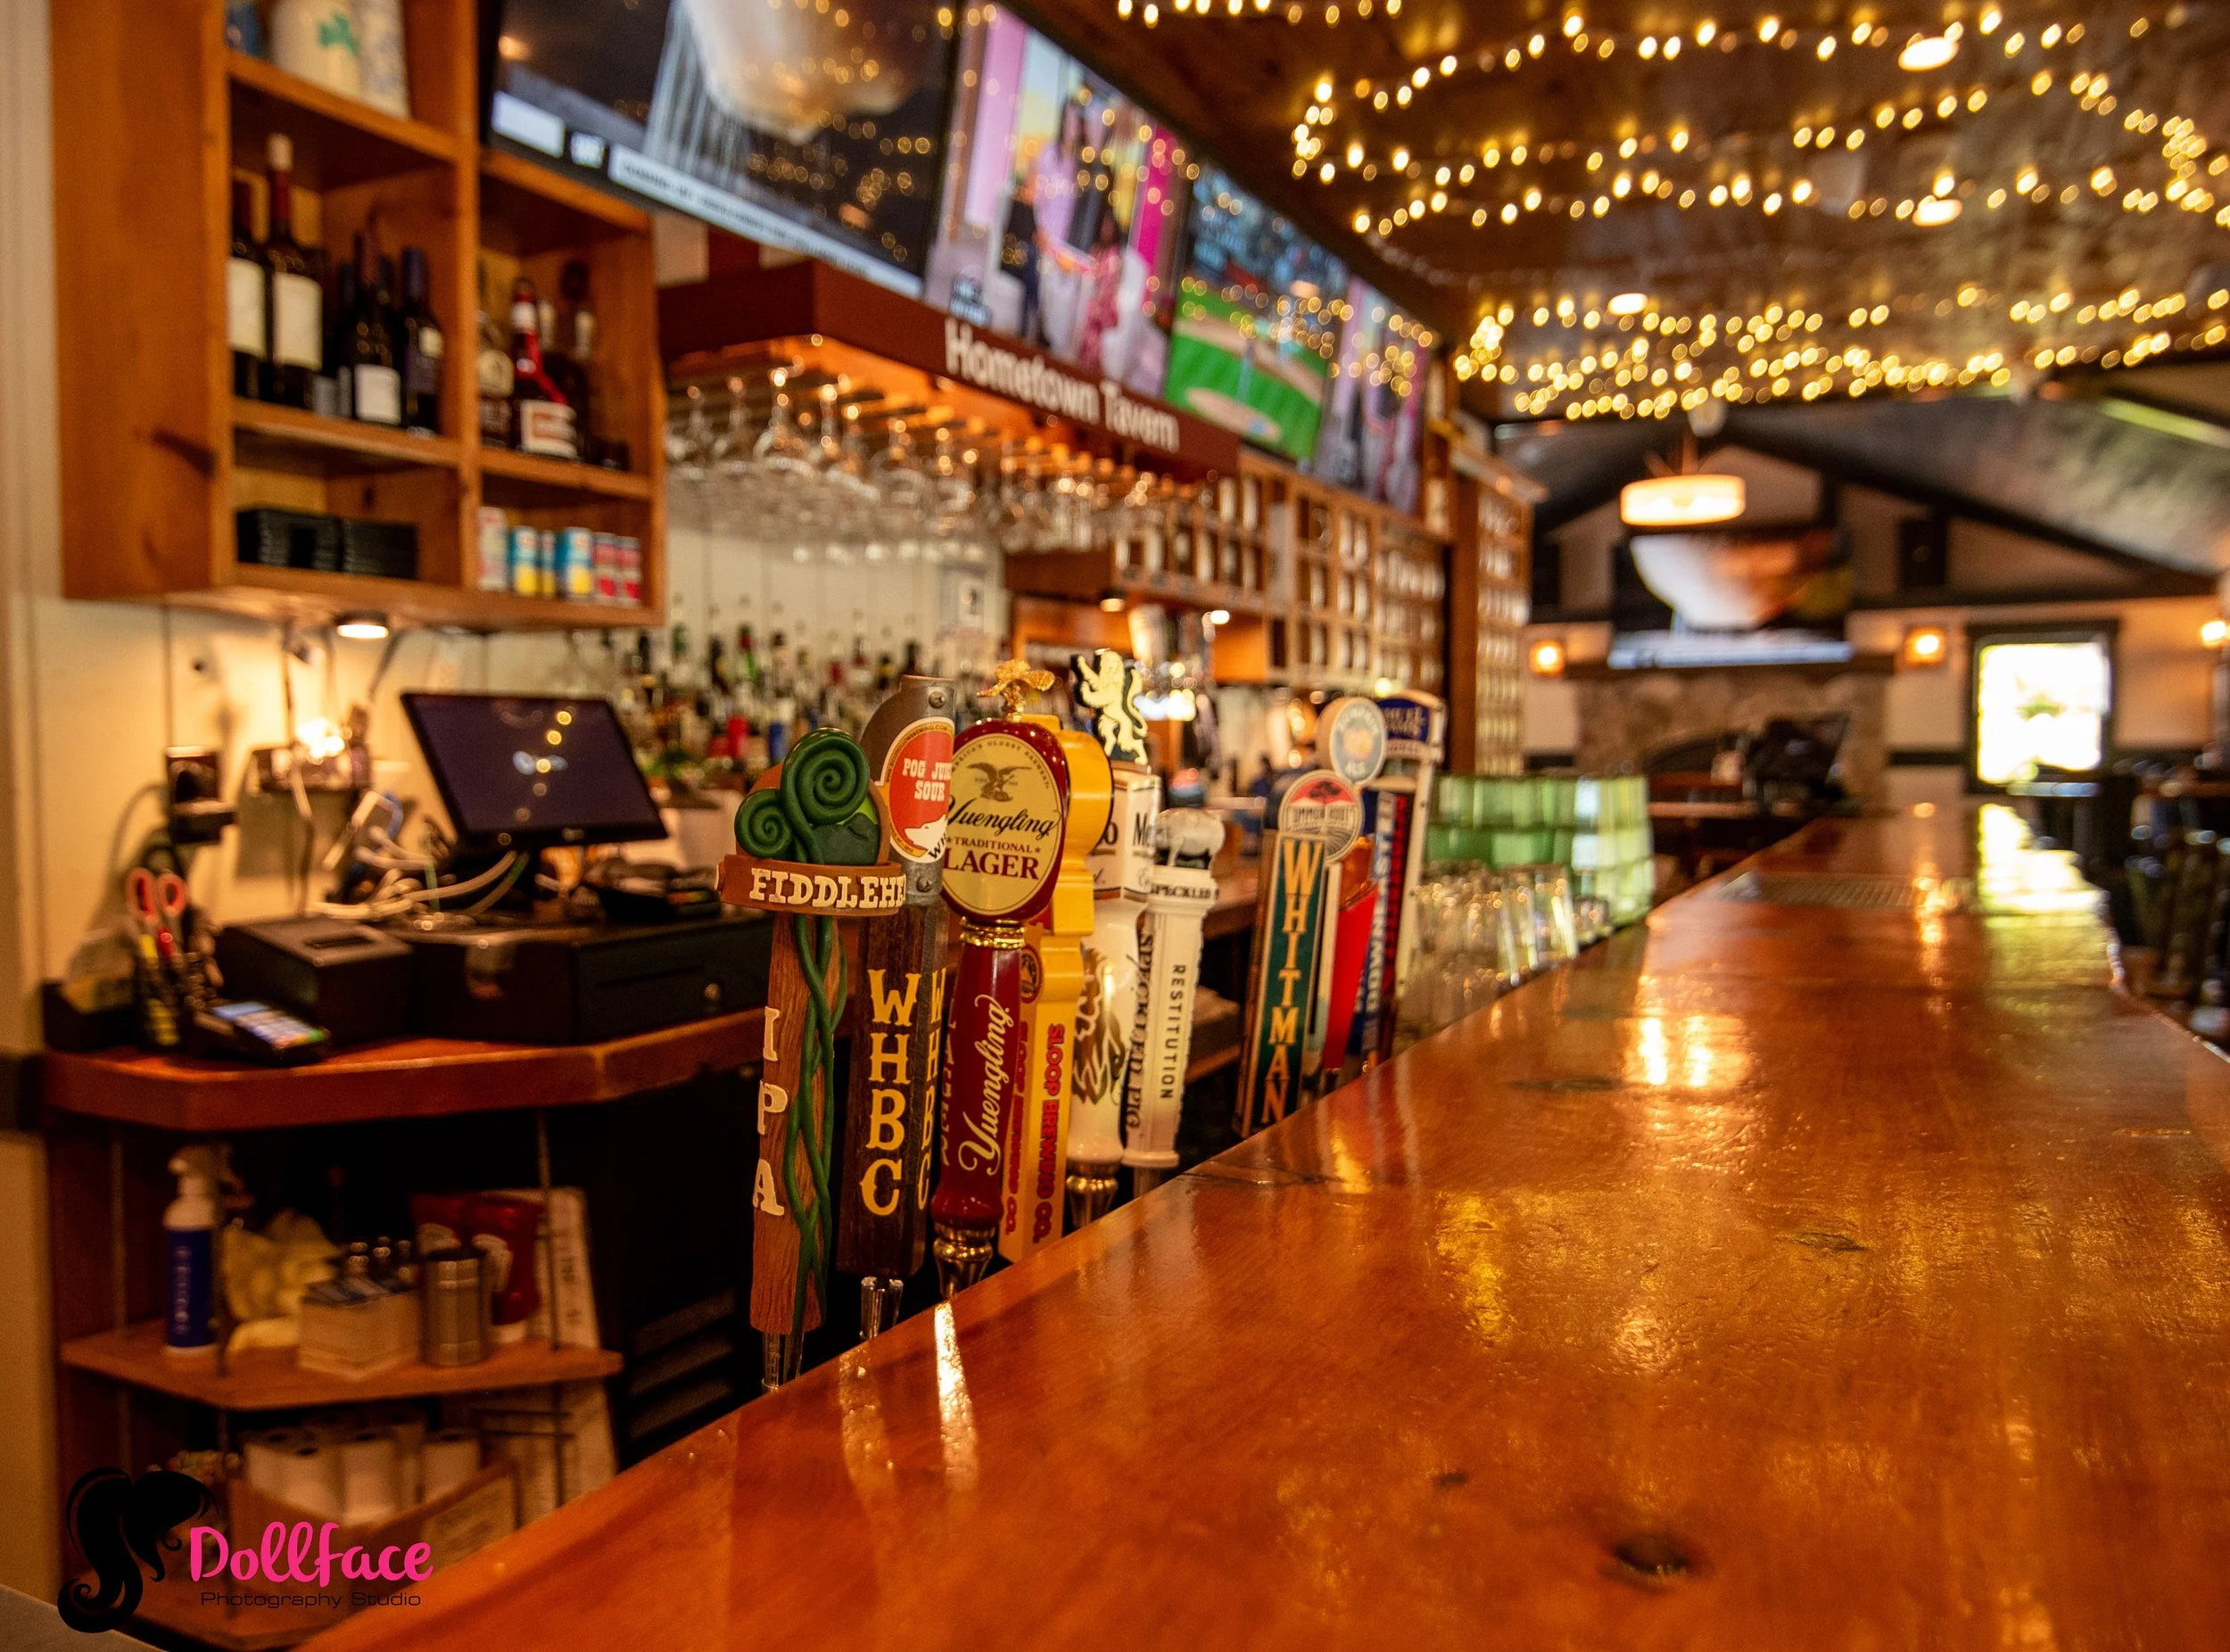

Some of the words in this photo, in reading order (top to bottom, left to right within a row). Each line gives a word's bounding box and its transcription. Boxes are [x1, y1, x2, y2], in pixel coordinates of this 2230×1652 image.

[945, 317, 1100, 425] Hometown
[1100, 379, 1180, 454] Tavern
[902, 757, 926, 778] POG
[914, 780, 946, 802] SOUR
[948, 794, 1061, 840] Yuengling
[954, 836, 1033, 854] TRADITIONAL
[749, 868, 906, 909] FIDDLEHE
[943, 847, 1039, 880] LAGER
[1261, 839, 1323, 1123] WHITMAN
[1044, 1023, 1065, 1096] SLOOP
[1160, 963, 1186, 1099] RESTITUTION
[753, 1006, 788, 1216] IPA
[860, 969, 921, 1216] WHBC
[918, 967, 946, 1210] WHBC
[958, 994, 1014, 1176] Yuengling
[1126, 1085, 1141, 1128] PIG
[1037, 1099, 1060, 1199] BREWING
